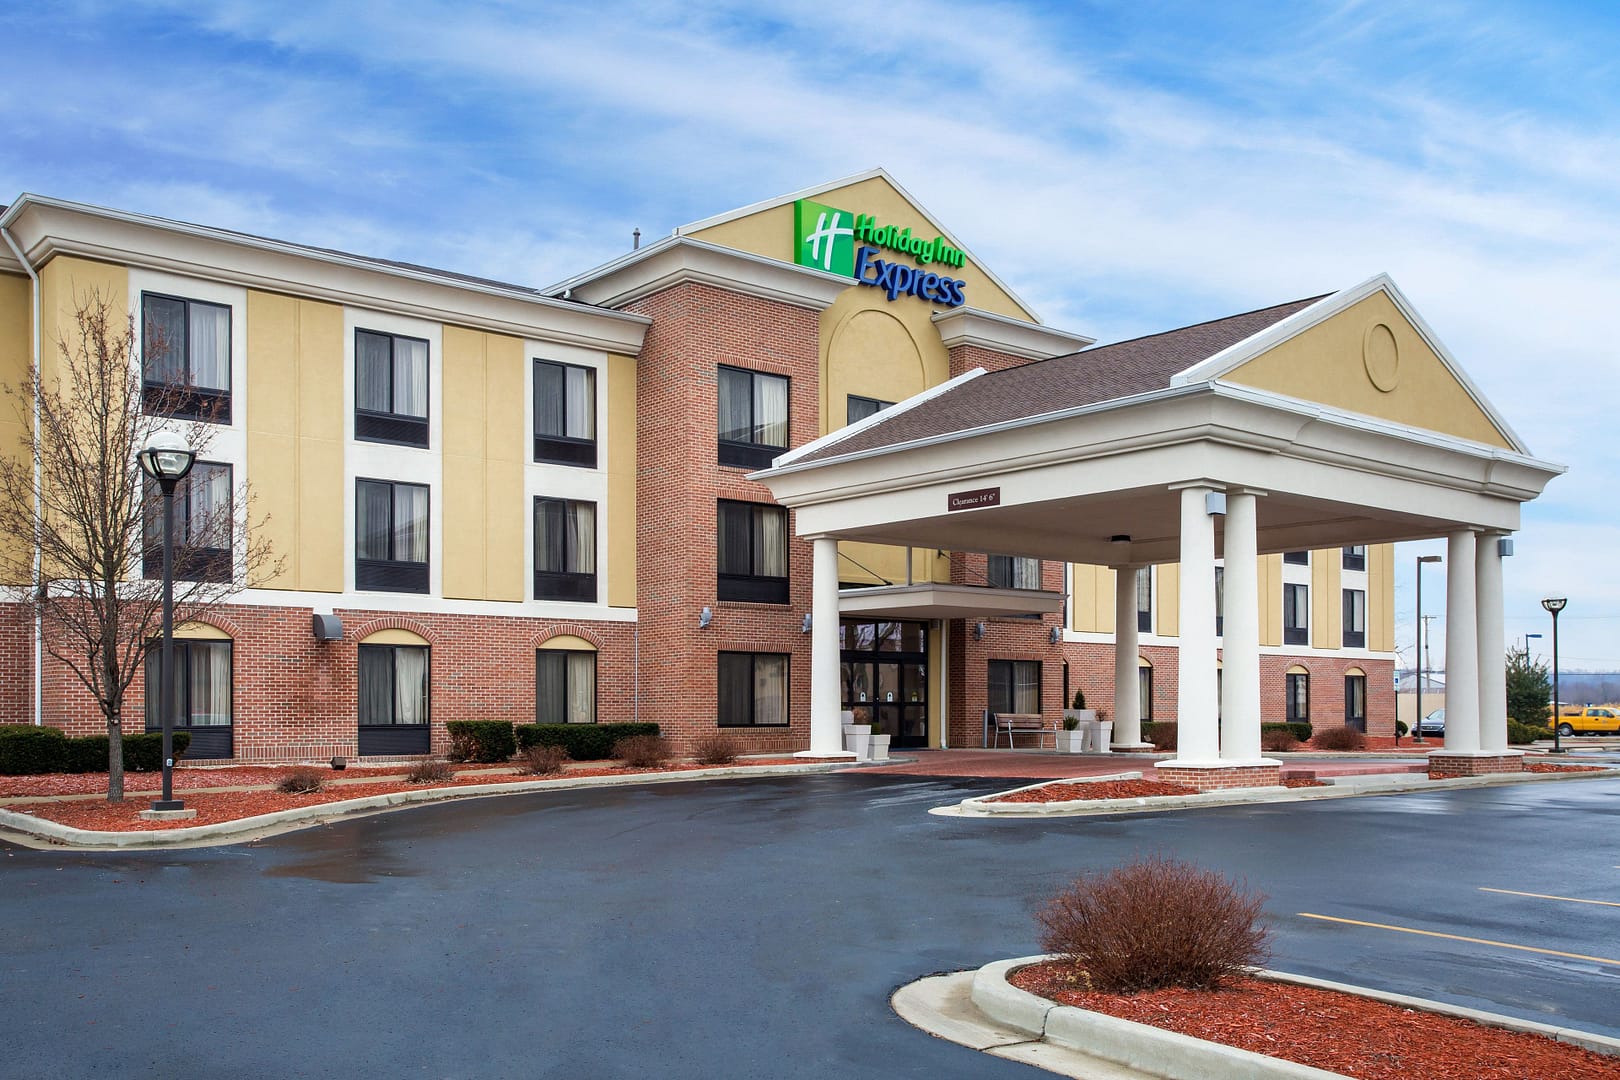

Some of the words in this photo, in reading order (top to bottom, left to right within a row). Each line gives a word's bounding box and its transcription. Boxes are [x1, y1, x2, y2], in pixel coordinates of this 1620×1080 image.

[854, 213, 933, 264] Holiday
[932, 236, 966, 269] Inn
[854, 246, 966, 306] Express
